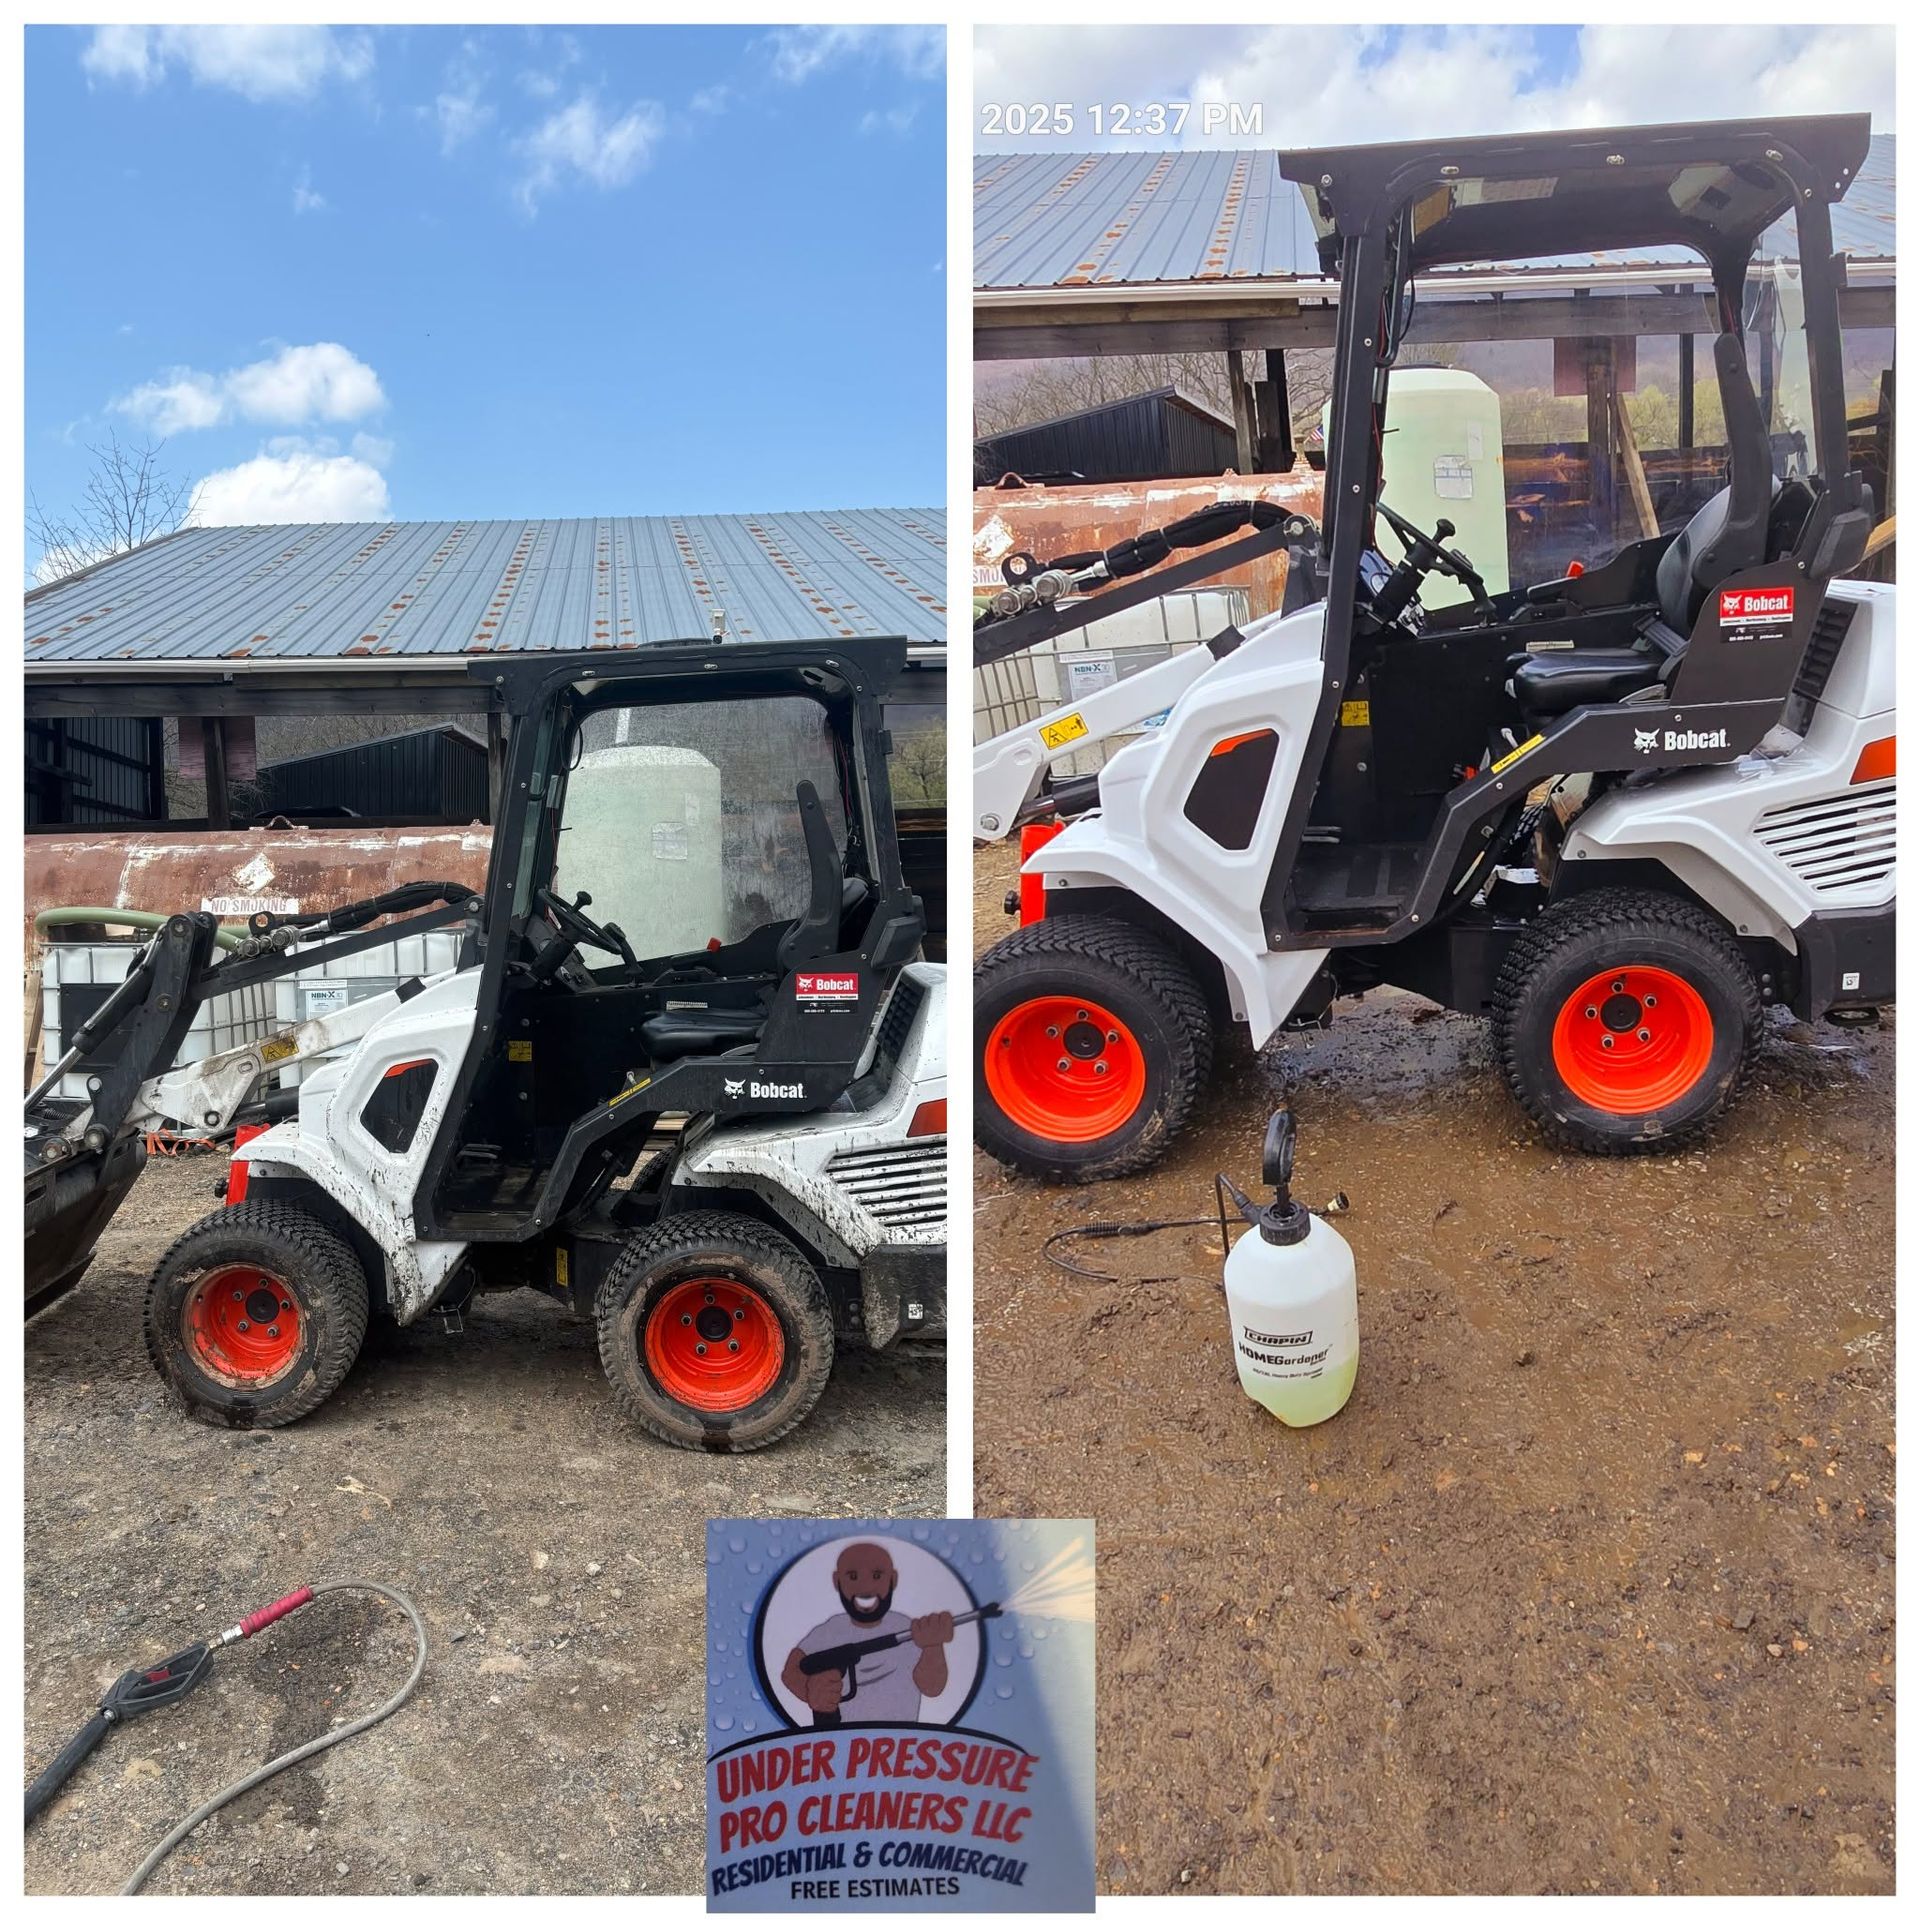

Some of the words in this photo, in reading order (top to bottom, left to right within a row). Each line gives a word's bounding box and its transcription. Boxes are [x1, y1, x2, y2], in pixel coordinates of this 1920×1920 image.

[1744, 594, 1788, 612] Bobcat
[1664, 728, 1727, 751] Bobcat
[211, 899, 227, 912] NO
[232, 899, 287, 912] SMOKING
[816, 978, 854, 991] Bobcat
[750, 1082, 804, 1099] Bobcat
[1248, 1332, 1308, 1345] CHAPIN
[1239, 1341, 1329, 1366] HOMEGardener
